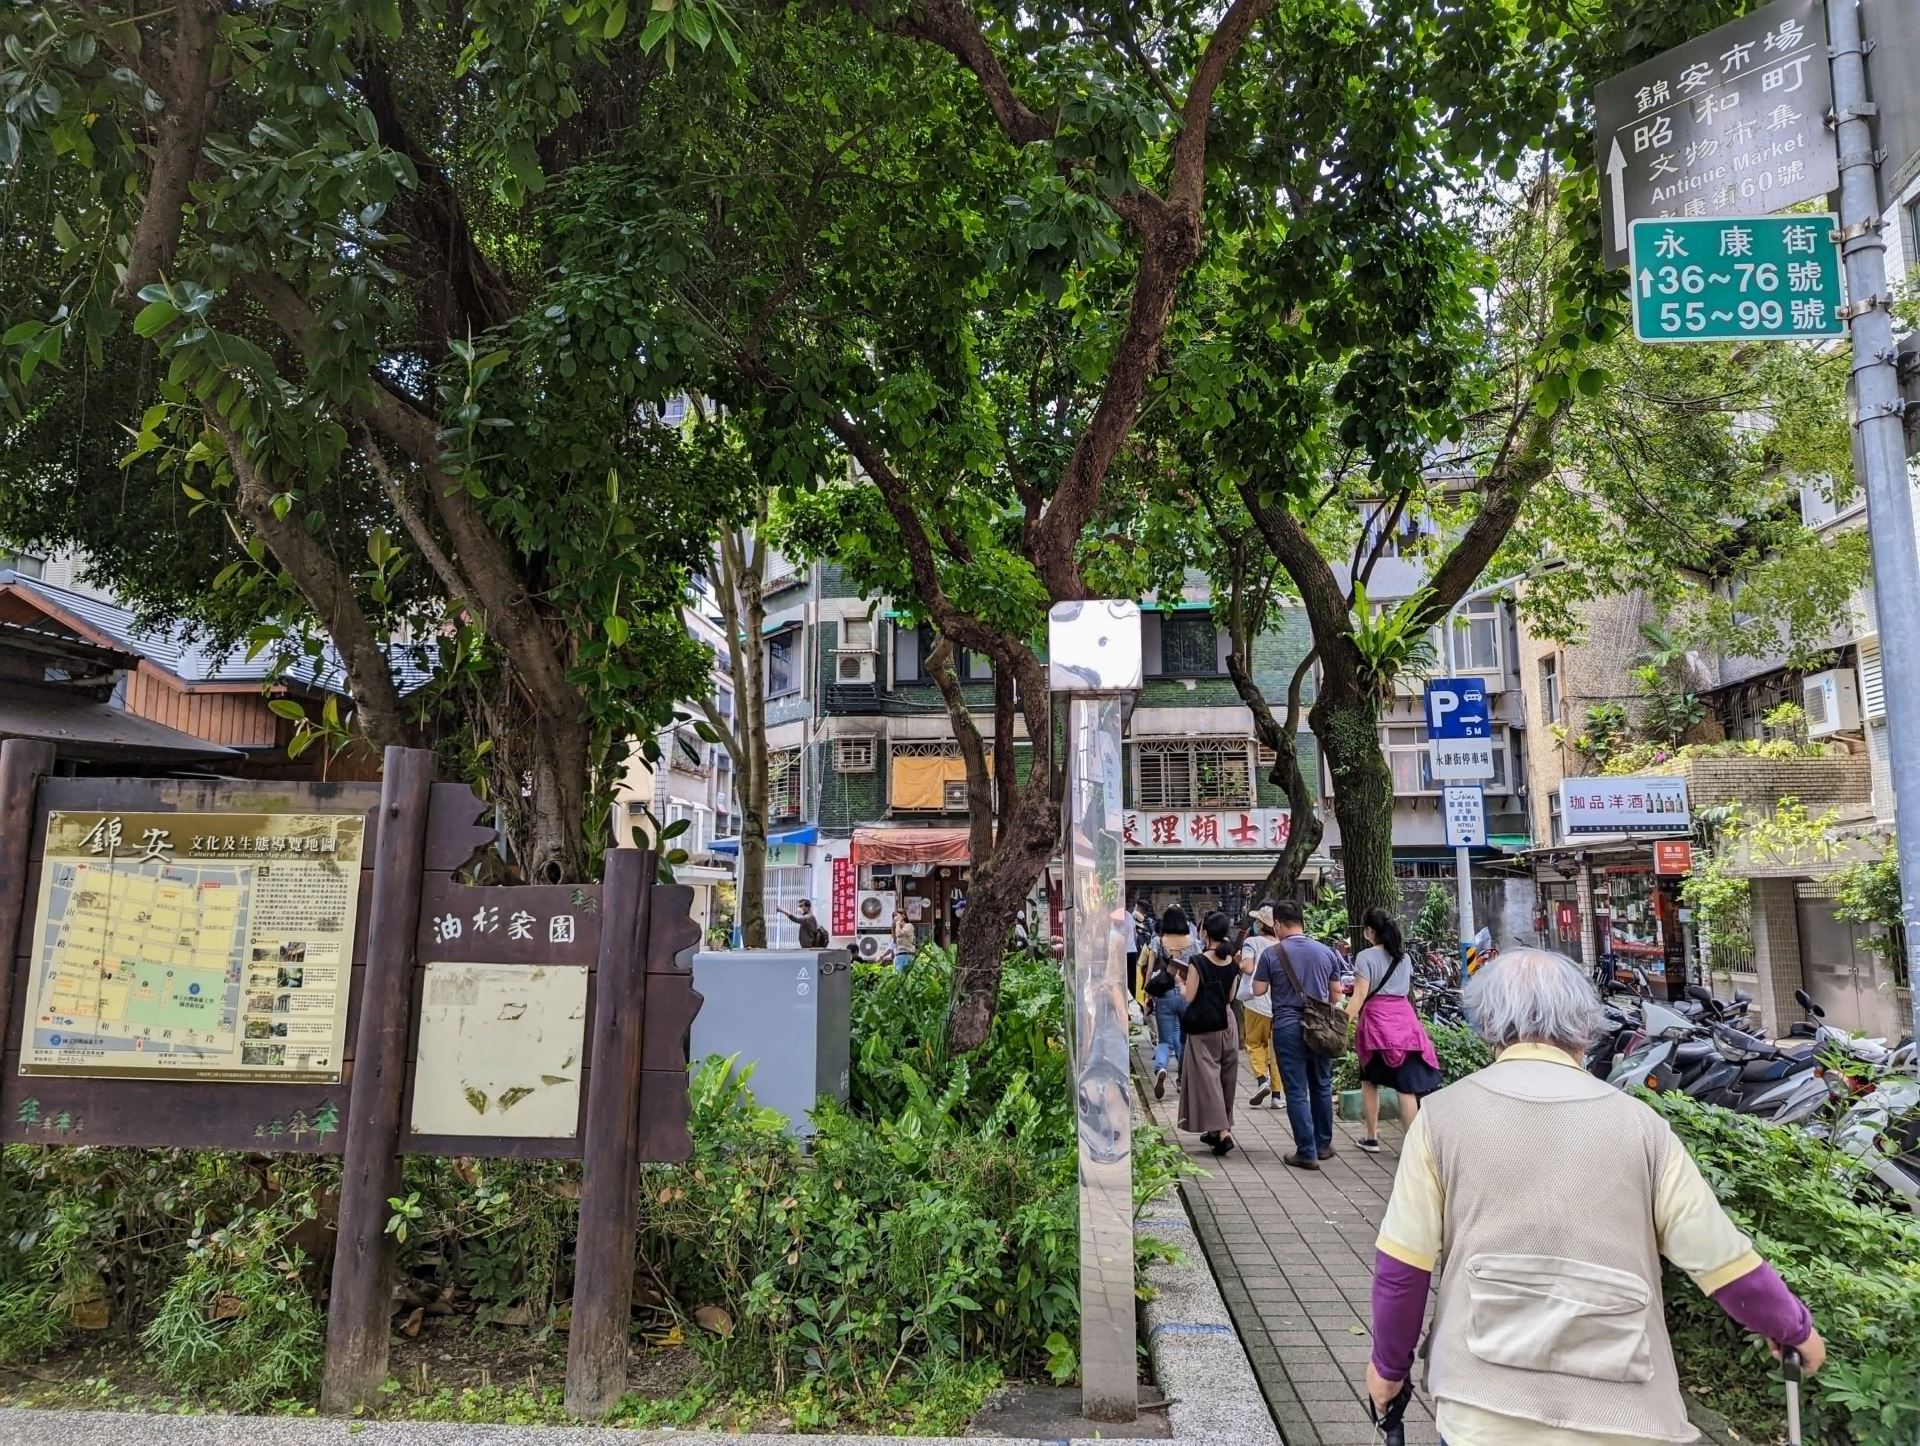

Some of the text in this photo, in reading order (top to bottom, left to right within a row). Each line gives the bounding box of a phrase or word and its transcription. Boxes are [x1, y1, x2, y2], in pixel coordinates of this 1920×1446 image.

[1634, 18, 1805, 114] 錦安市場
[1633, 54, 1811, 153] 昭和町
[1648, 103, 1802, 182] 文物市集
[1651, 132, 1804, 205] Antique Market
[1654, 224, 1818, 259] 永康街
[1430, 690, 1459, 728] P
[1436, 752, 1489, 766] 永康街停車場
[1569, 794, 1643, 810] 珈品洋酒
[79, 816, 174, 863] 錦安
[189, 835, 337, 853] 文化及生態導覽地圖
[230, 851, 263, 859] Ecological
